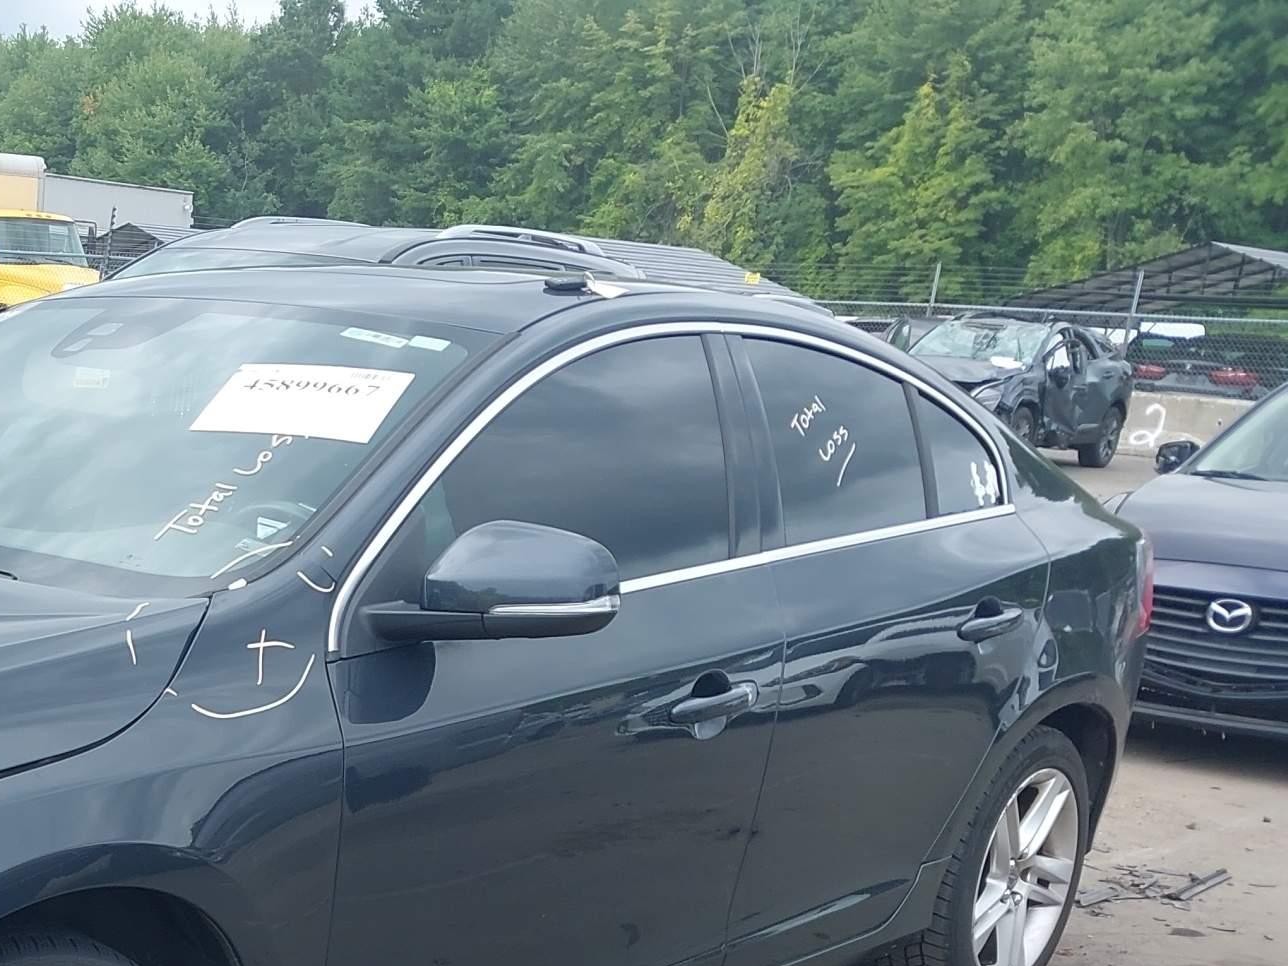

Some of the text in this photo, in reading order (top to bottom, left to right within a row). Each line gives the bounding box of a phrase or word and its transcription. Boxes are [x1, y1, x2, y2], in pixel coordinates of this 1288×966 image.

[243, 378, 380, 397] 45899667
[154, 434, 309, 541] Total Los
